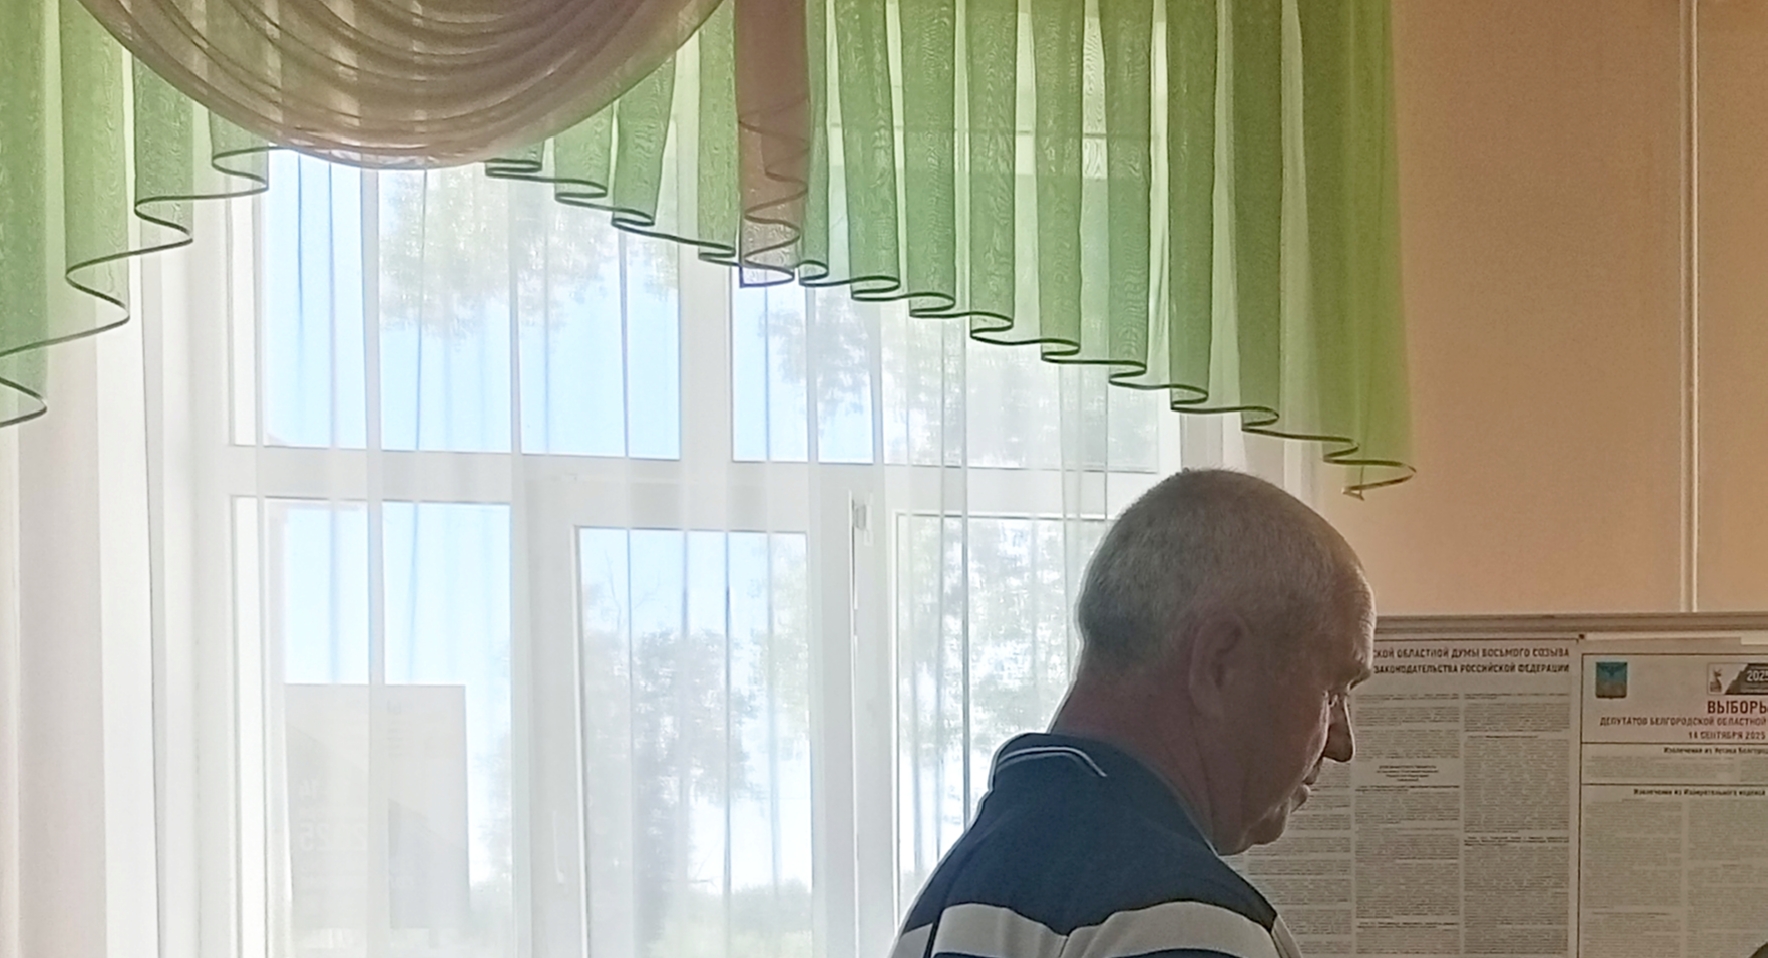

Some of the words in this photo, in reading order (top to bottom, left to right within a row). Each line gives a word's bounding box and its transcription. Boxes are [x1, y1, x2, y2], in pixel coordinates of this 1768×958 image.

[1451, 648, 1480, 659] ДУМЫ
[1533, 648, 1570, 658] СОЗЫВА
[1460, 663, 1516, 673] РОССИЙСКОЙ
[1518, 664, 1570, 674] ФЕДЕРАЦИИ
[1600, 716, 1648, 727] ДЕПУТАТОВ
[1650, 715, 1714, 727] БЕЛГОРОДСКОЙ
[1716, 716, 1767, 727] ОБЛАСТНОЙ
[1701, 731, 1743, 740] СЕНТЯБРЯ
[1745, 731, 1766, 740] 2025
